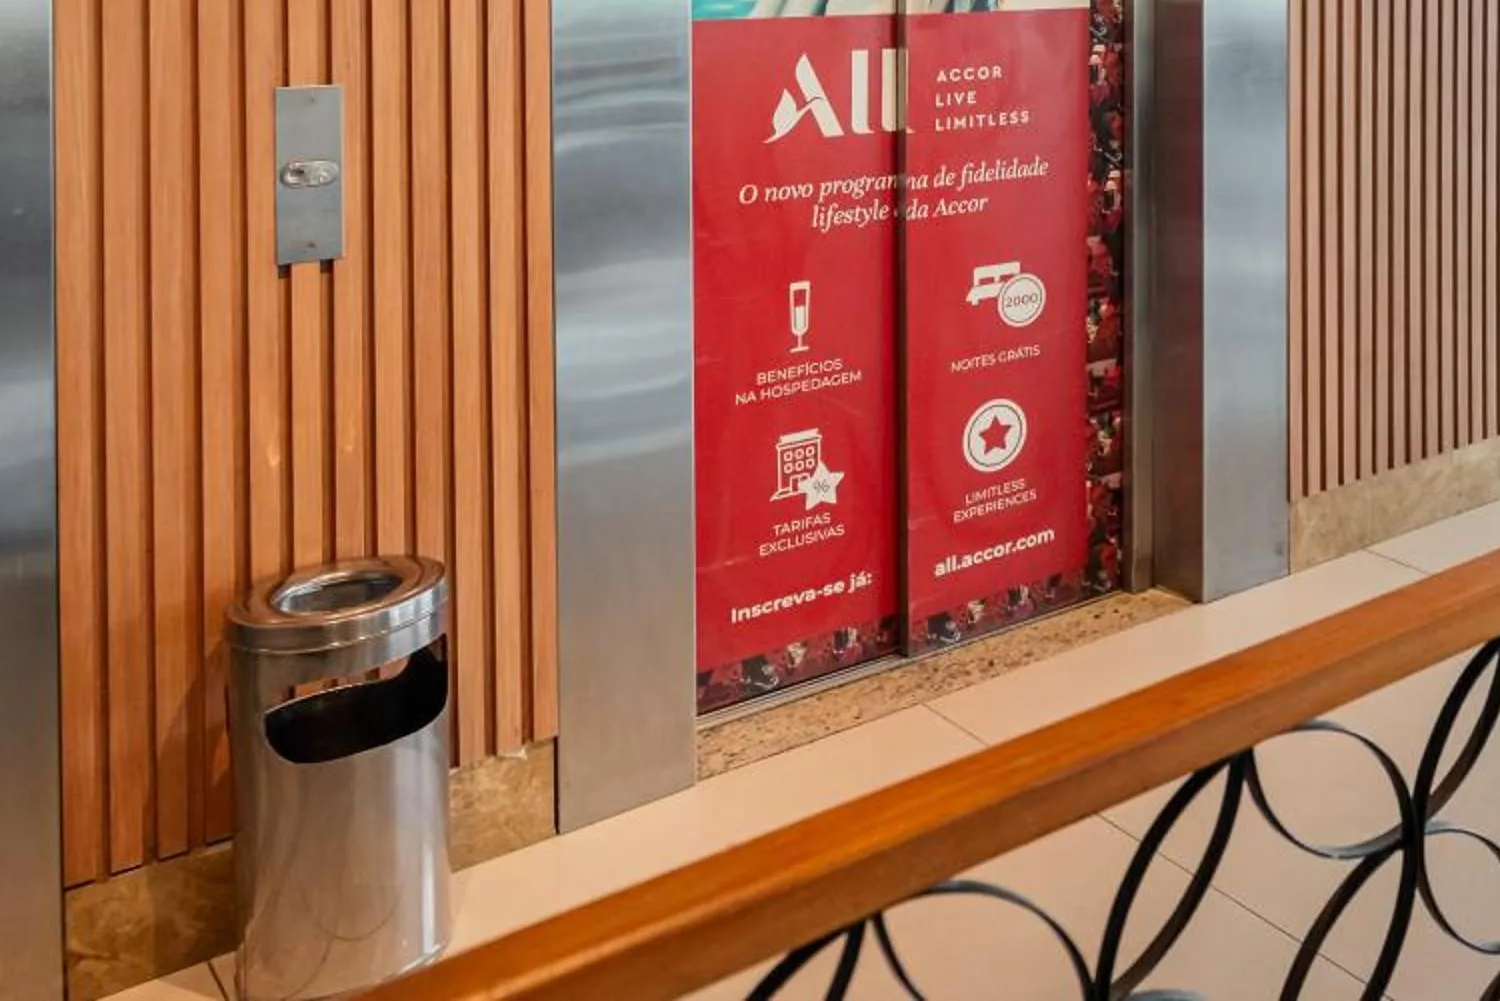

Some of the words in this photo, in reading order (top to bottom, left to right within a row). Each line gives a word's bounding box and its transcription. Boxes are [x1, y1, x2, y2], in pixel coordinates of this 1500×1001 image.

[936, 65, 1003, 83] ACCOR
[935, 90, 977, 108] LIVE
[935, 110, 1030, 132] LIMITLESS
[739, 184, 758, 204] O
[764, 182, 813, 203] novo
[933, 163, 957, 188] de
[956, 155, 1049, 192] fidelidade
[811, 198, 890, 234] lifestyle
[906, 198, 929, 221] da
[932, 197, 989, 219] Accor
[950, 353, 997, 373] NOITES
[735, 390, 757, 405] NA
[760, 369, 863, 401] HOSPEDAGEM
[953, 488, 1037, 524] EXPERIENCES
[965, 478, 1026, 506] LIMITLESS
[758, 523, 846, 557] EXCLUSIVAS
[772, 512, 832, 538] TARIFAS
[934, 528, 1055, 577] all.accor.com
[731, 580, 846, 624] Inscreva-se
